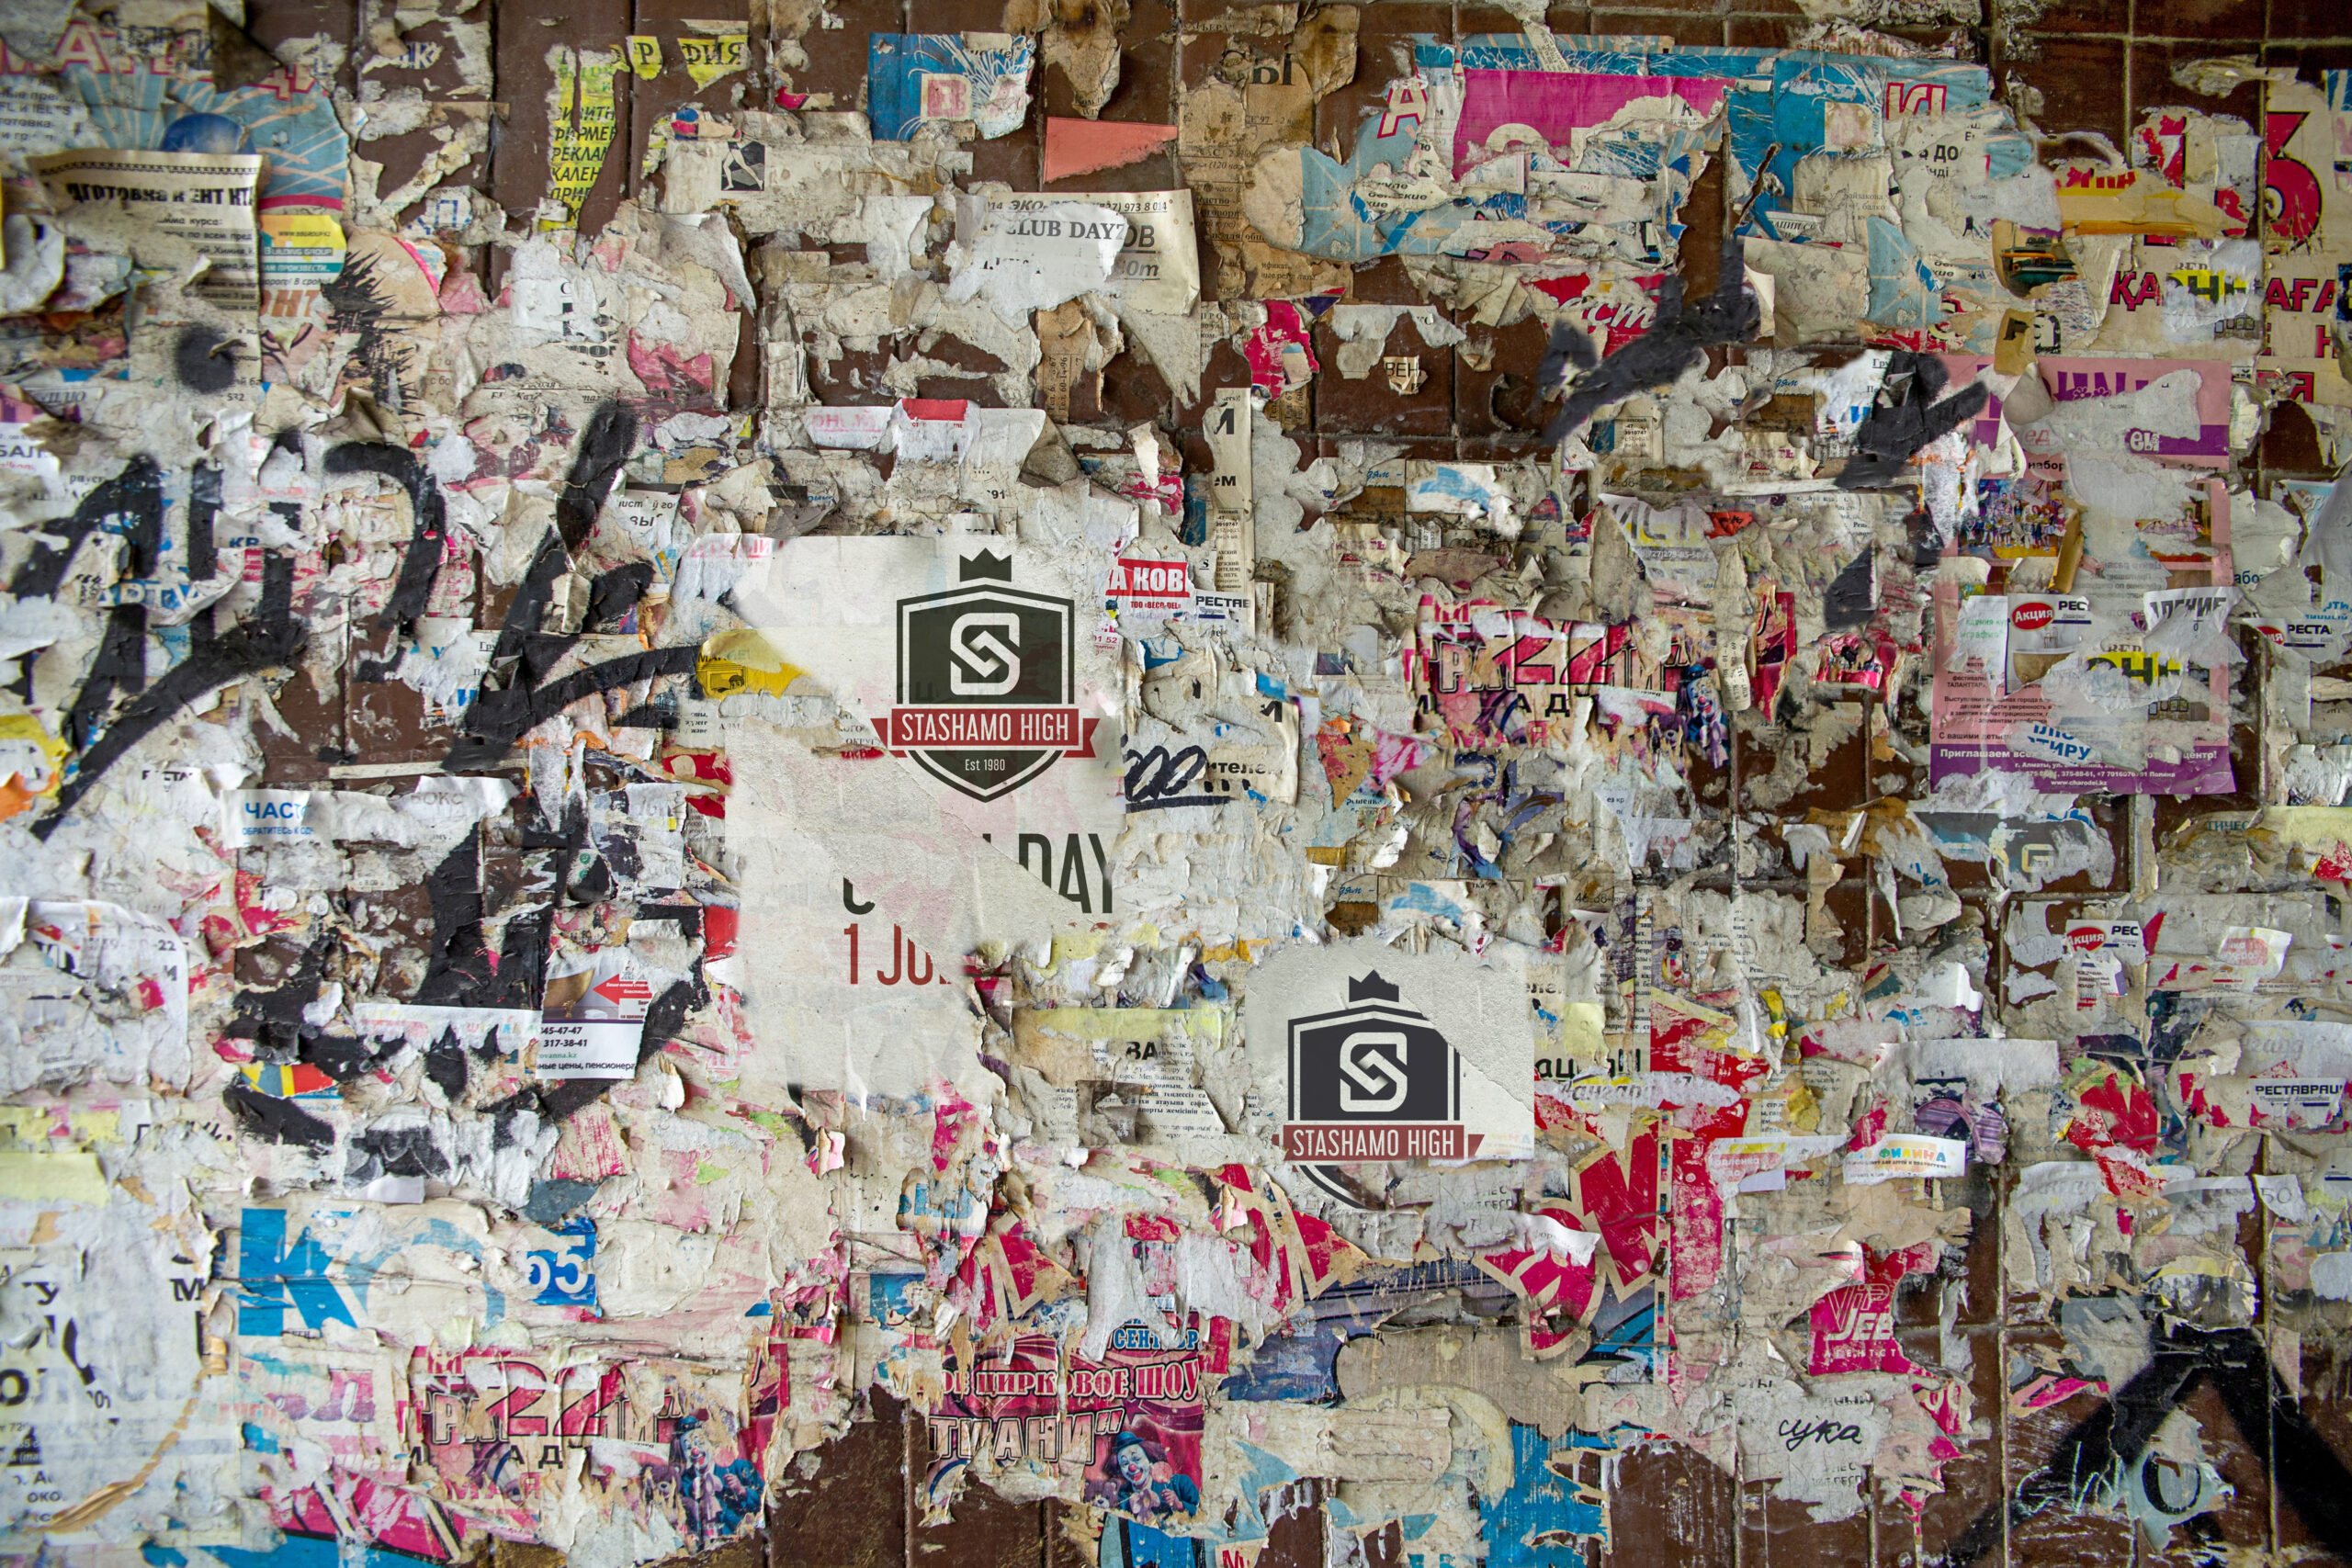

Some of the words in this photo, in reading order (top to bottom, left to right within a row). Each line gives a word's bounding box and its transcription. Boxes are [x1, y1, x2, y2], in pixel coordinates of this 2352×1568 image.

[1124, 201, 1141, 212] 973
[1143, 201, 1151, 211] 8
[1133, 566, 1188, 592] КОВ
[1130, 601, 1144, 610] ТОО
[901, 713, 1012, 742] STASHAMO
[1020, 713, 1069, 742] HIGH
[1939, 748, 2011, 761] Приглашаем
[965, 758, 981, 772] Est
[983, 758, 1006, 772] 1980
[242, 826, 293, 836] ОБРАТИТЕСЬ
[876, 922, 952, 987] JU
[543, 1039, 588, 1048] 317-38-41
[558, 1062, 584, 1071] цены,
[1292, 1128, 1400, 1157] STASHAMO
[1408, 1128, 1454, 1157] HIGH
[1114, 1328, 1203, 1349] СЕНТР
[1135, 1359, 1200, 1402] ШОУ
[1778, 1416, 1864, 1453] сука
